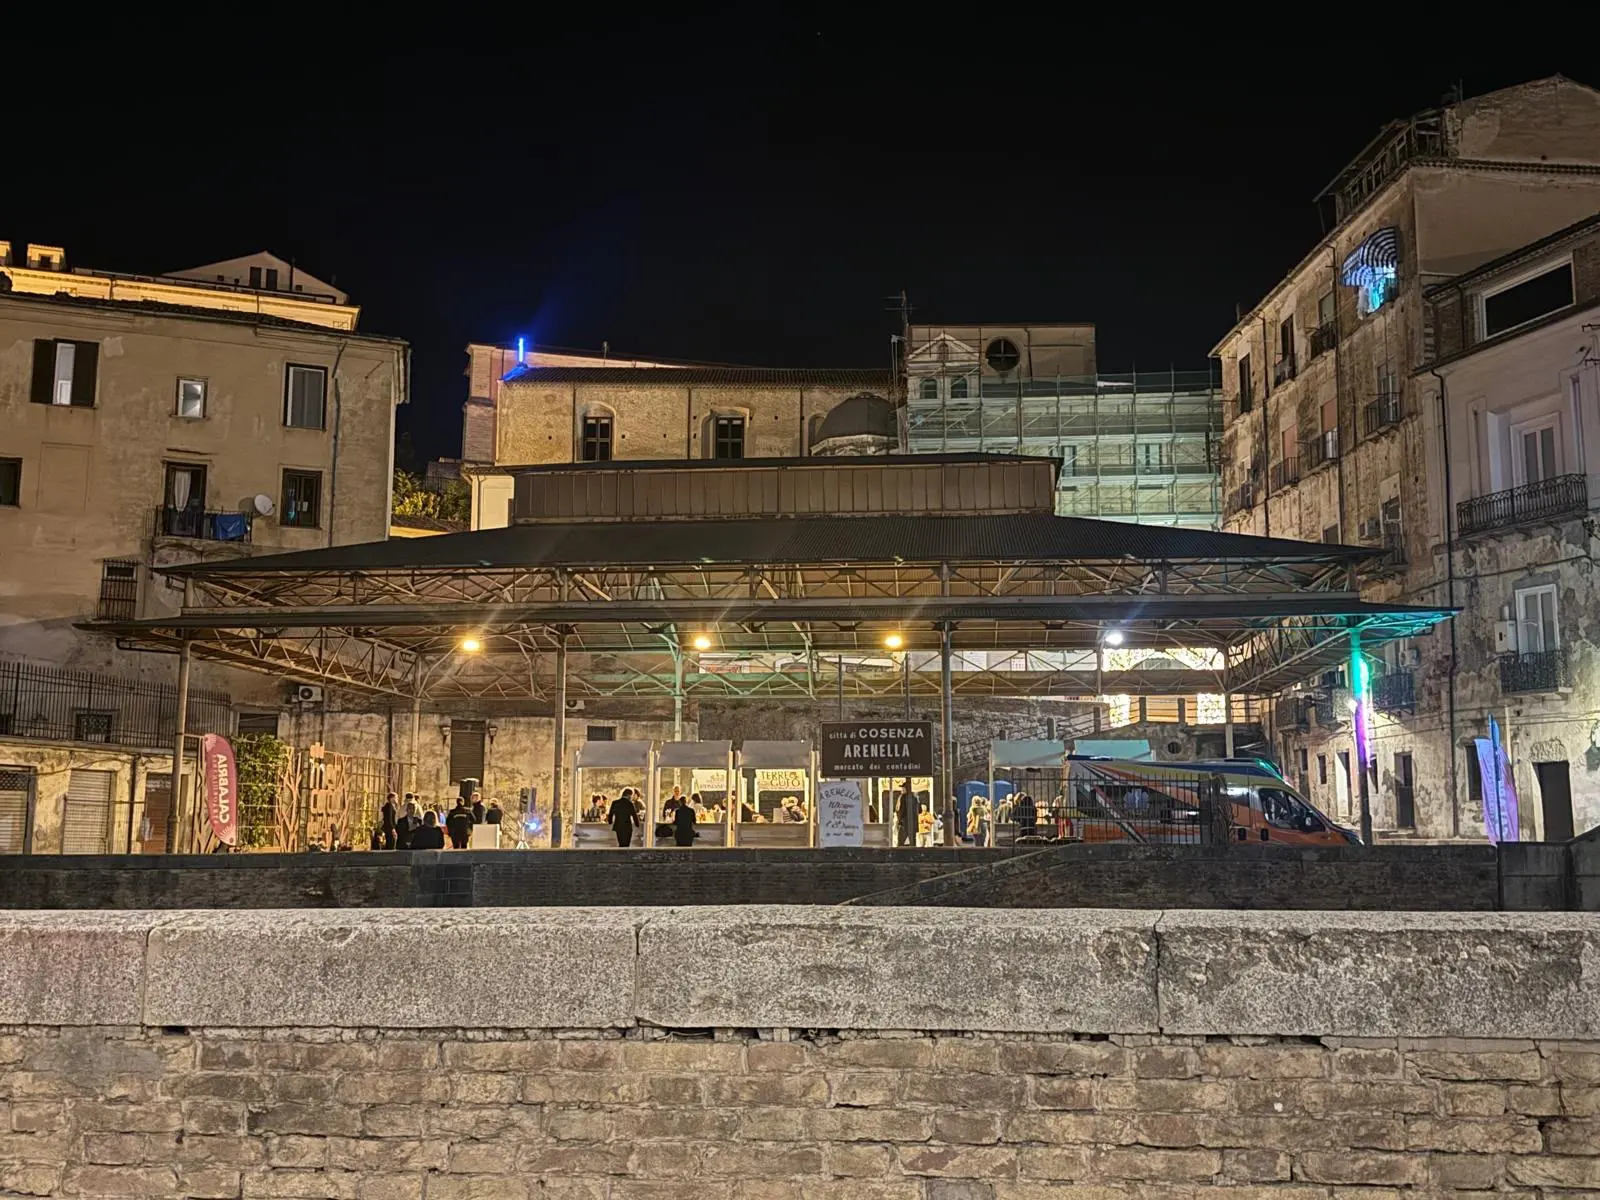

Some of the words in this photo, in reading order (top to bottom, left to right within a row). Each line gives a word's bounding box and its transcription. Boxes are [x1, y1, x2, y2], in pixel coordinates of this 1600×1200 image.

[849, 731, 856, 739] di
[859, 728, 924, 739] COSENZA
[844, 743, 910, 758] ARENELLA
[834, 763, 864, 771] mercato
[761, 771, 788, 780] TERRE
